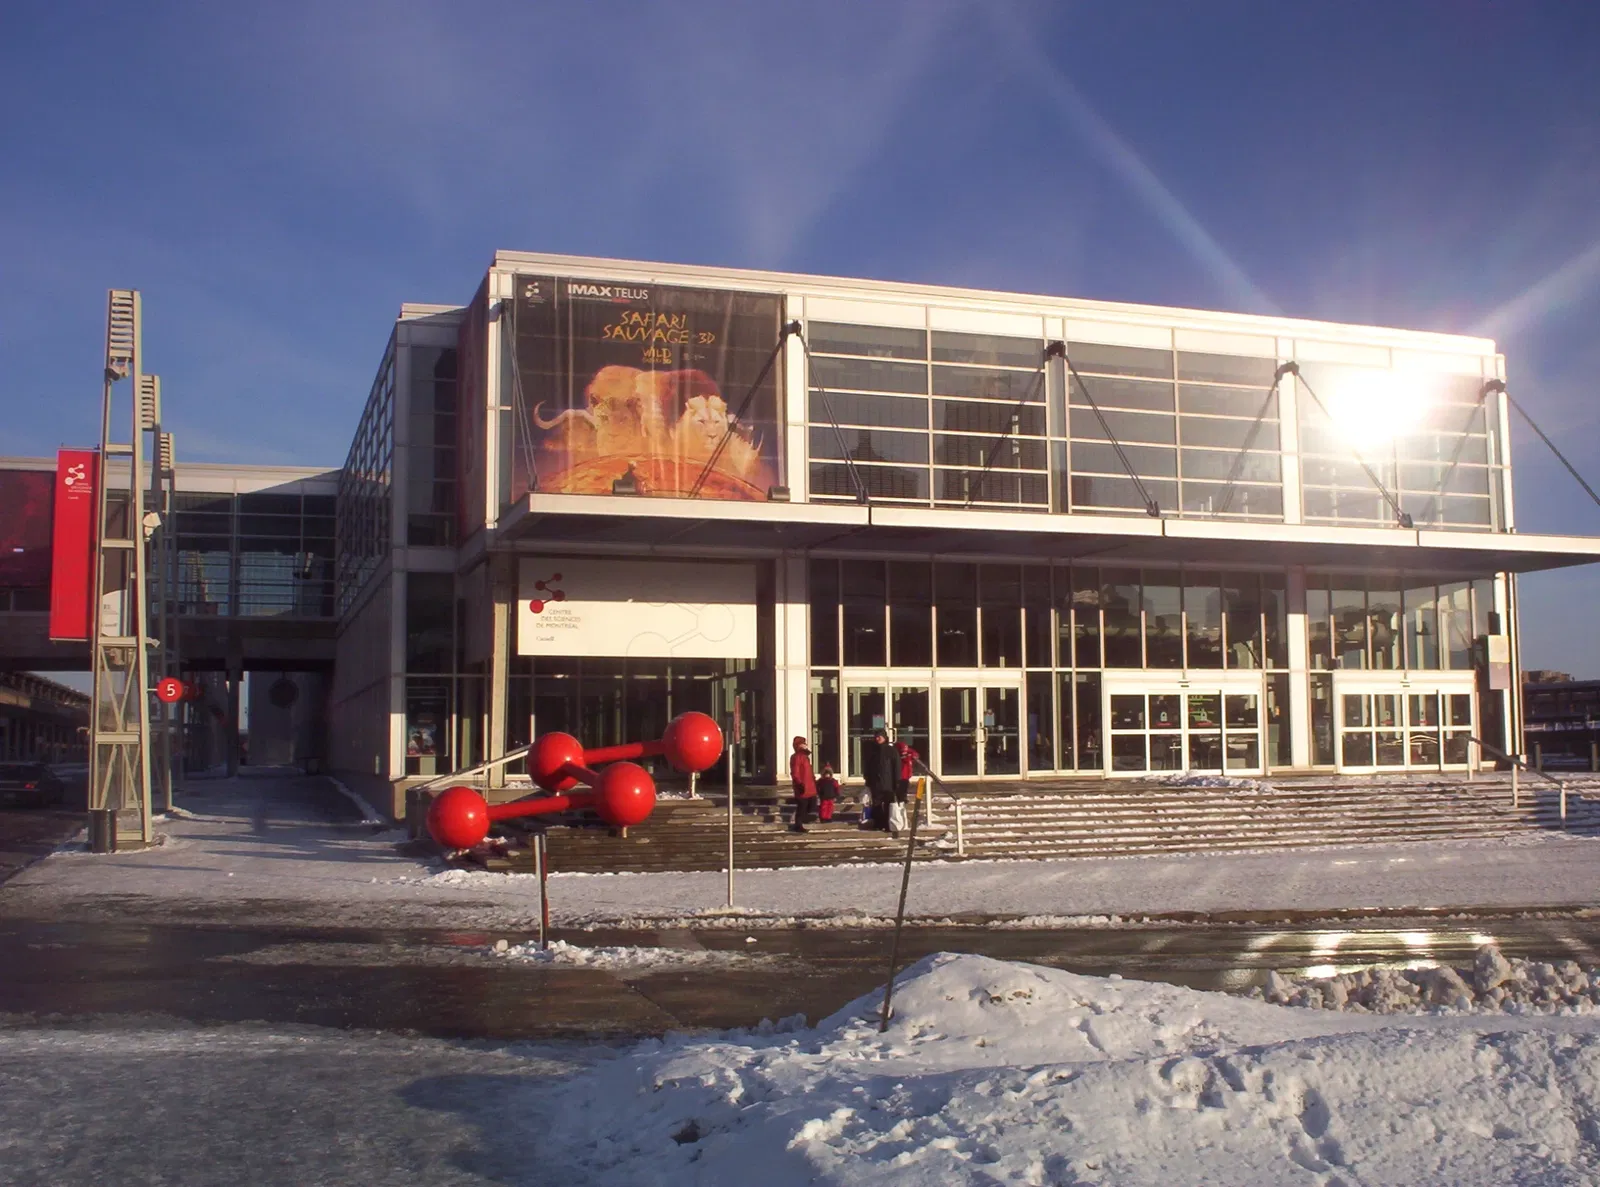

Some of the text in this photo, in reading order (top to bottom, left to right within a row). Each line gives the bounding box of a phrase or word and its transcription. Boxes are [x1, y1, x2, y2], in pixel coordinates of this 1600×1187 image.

[567, 283, 612, 297] IMAX
[614, 287, 649, 300] TELUS
[621, 311, 687, 329] SAFARI
[603, 325, 716, 345] SAUVAGE 3D
[166, 683, 176, 697] 5
